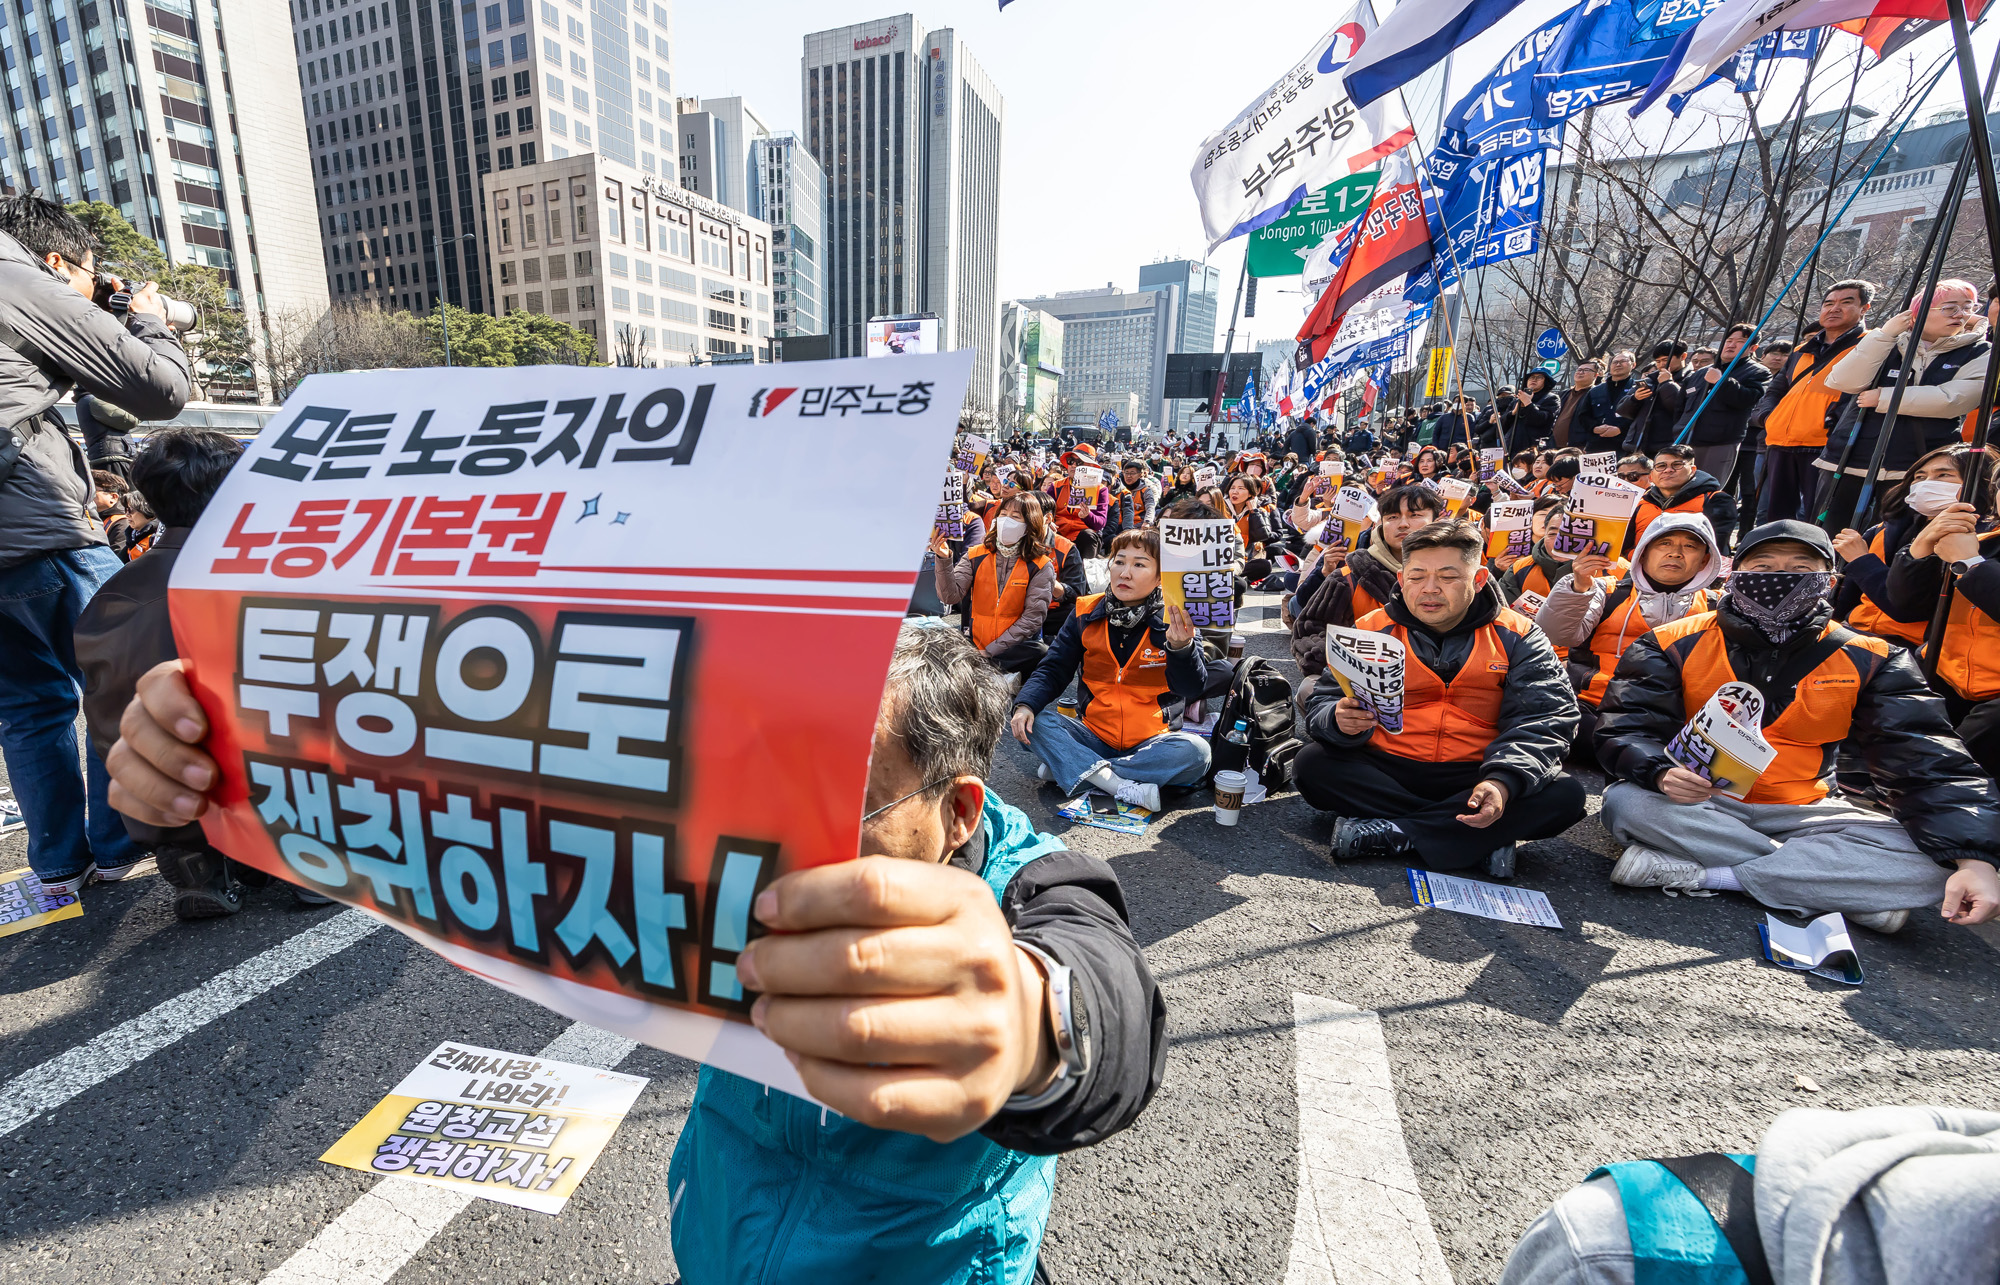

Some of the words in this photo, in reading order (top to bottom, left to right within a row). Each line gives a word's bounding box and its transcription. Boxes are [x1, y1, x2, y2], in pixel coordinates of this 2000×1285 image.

[854, 34, 891, 50] kobaco
[935, 60, 945, 116] 서울신문
[661, 182, 686, 202] SEOUL
[1260, 224, 1305, 242] Jongno
[798, 381, 935, 418] 민주노총
[250, 405, 396, 481] 모든
[399, 383, 716, 476] 노동자의
[1583, 455, 1616, 467] 진짜사장
[210, 491, 567, 578] 노동기본권
[1164, 524, 1234, 546] 진짜사장
[1183, 573, 1234, 598] 원청
[1184, 601, 1234, 627] 쟁취
[238, 605, 690, 794] 투쟁으로
[1737, 729, 1767, 753] 민주노총
[250, 760, 763, 1000] 쟁취하자!
[429, 1047, 542, 1080] 진짜사장
[460, 1079, 570, 1109] 나와라!
[399, 1101, 567, 1149] 원청교섭
[371, 1135, 576, 1192] 쟁취하자!
